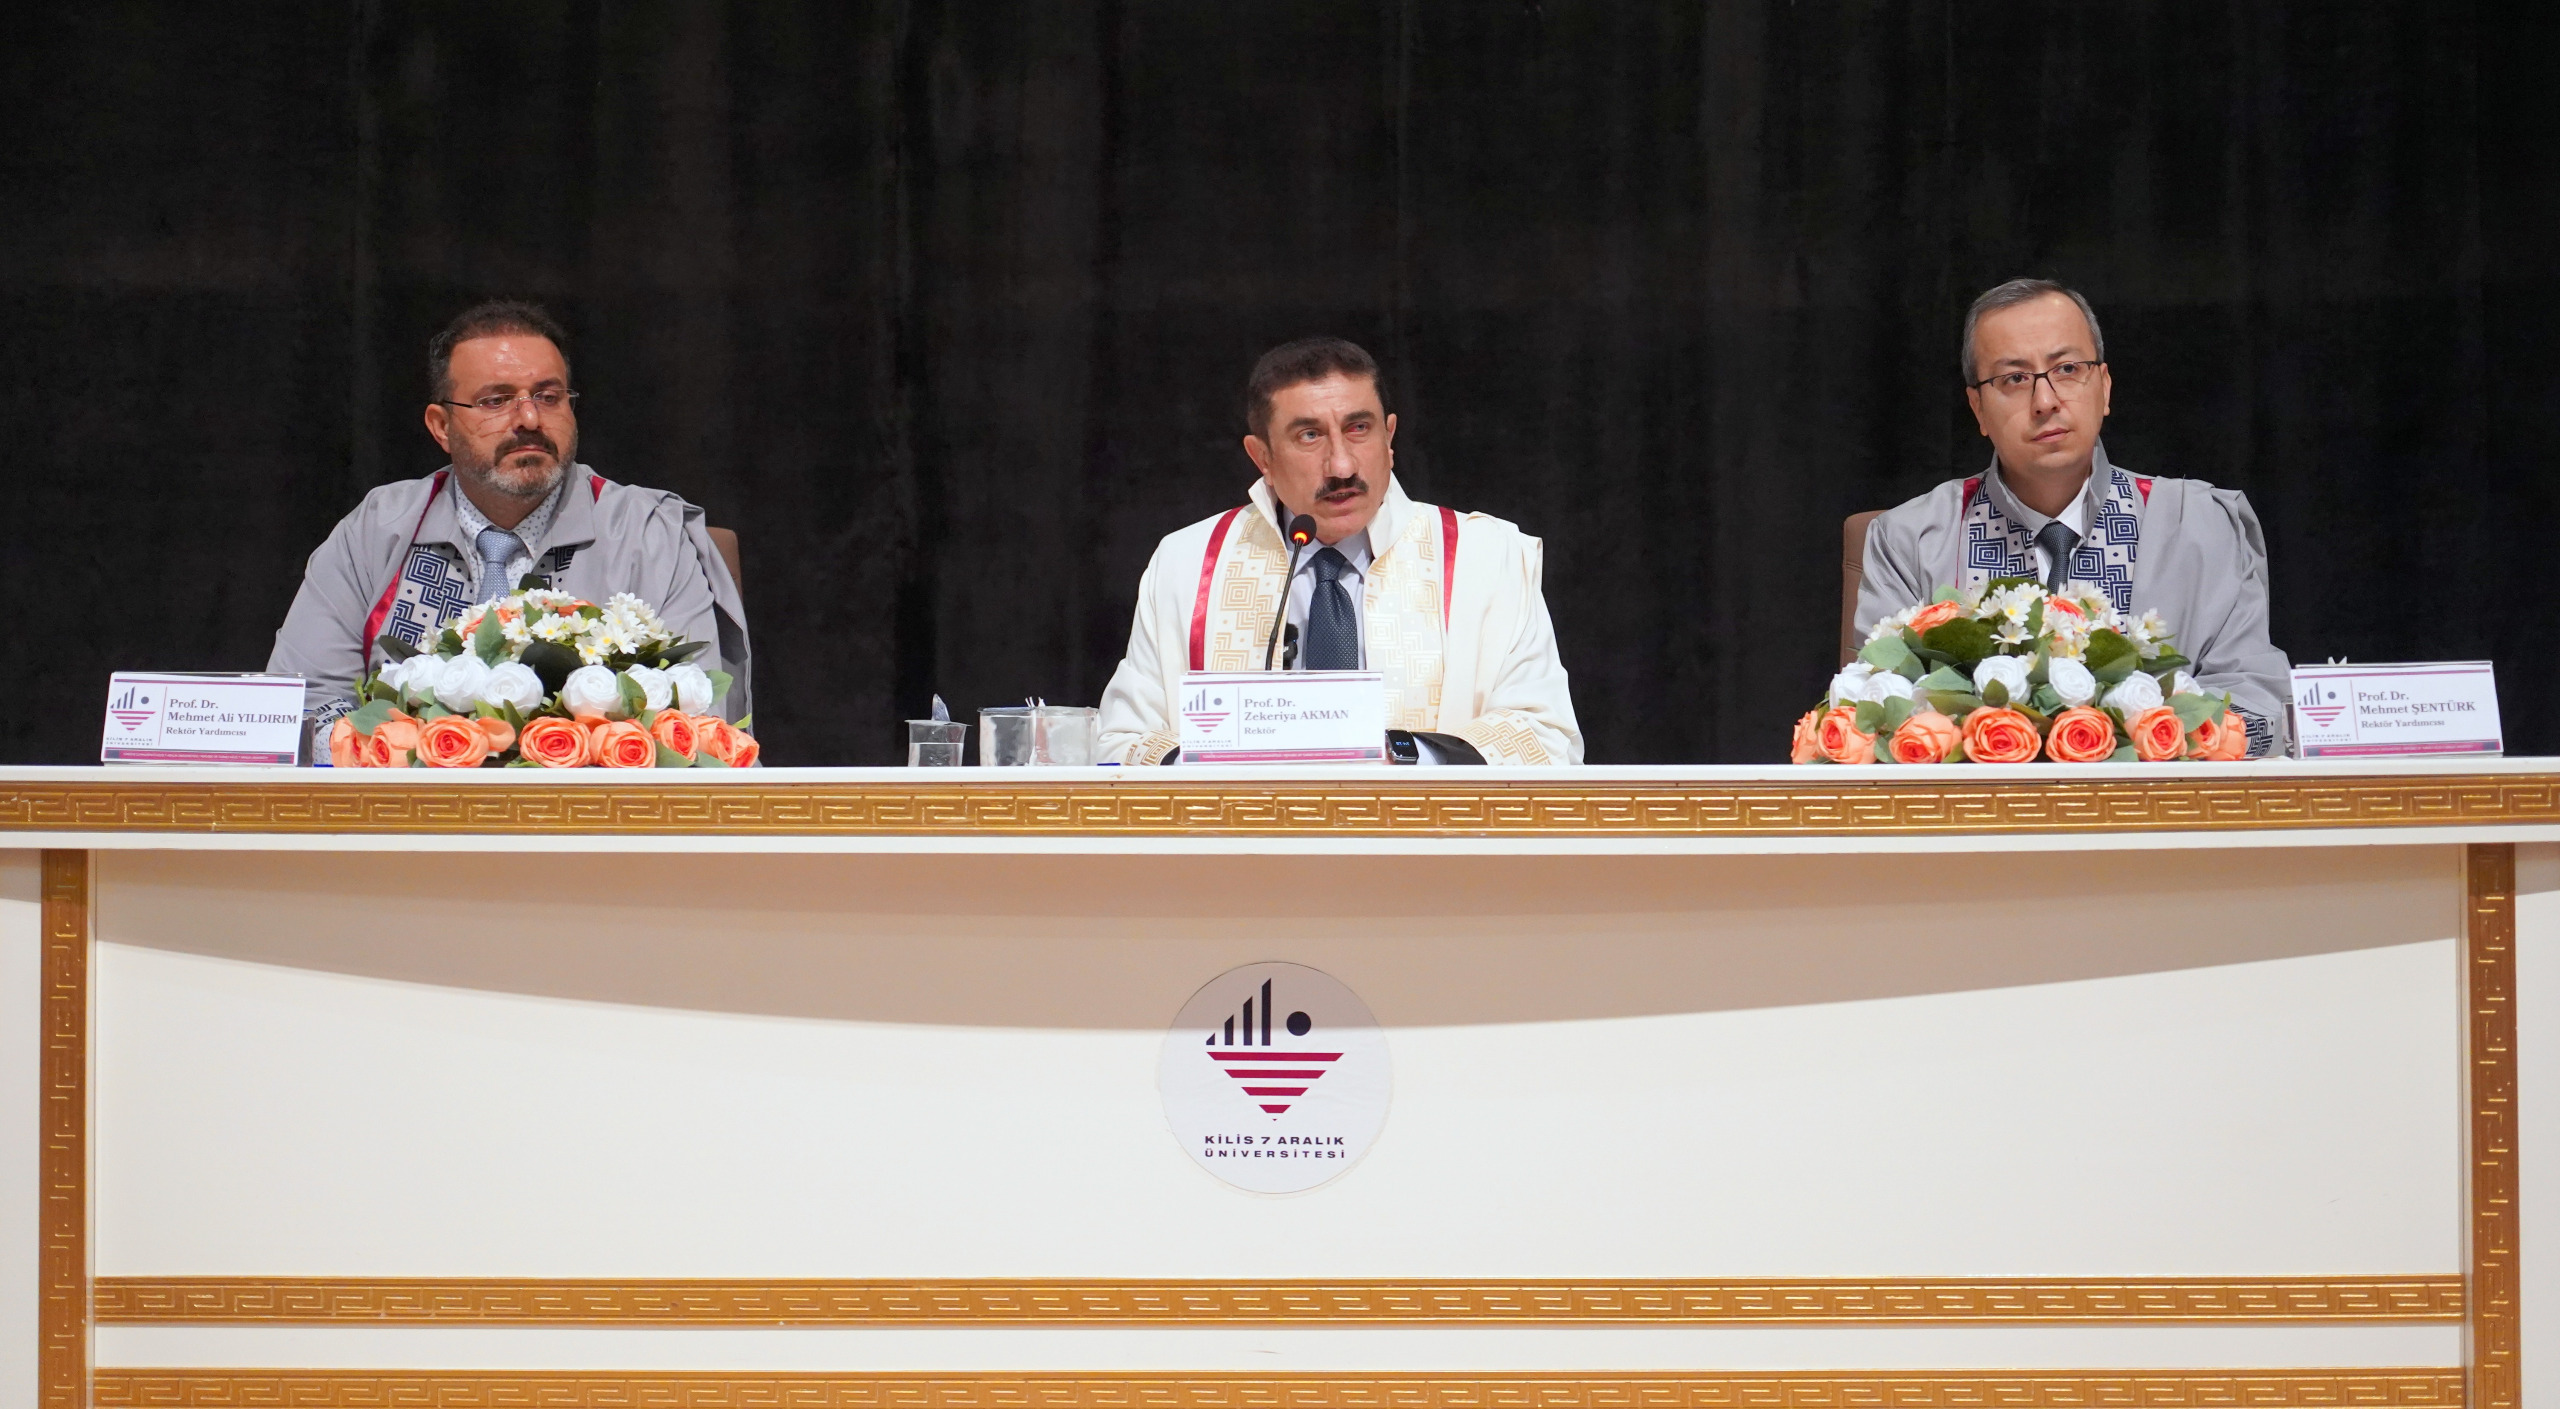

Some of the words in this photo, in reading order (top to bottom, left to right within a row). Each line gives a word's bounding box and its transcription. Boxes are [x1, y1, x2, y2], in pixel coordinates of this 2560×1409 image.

[2358, 691, 2388, 701] Prof.
[2390, 690, 2410, 701] Dr.
[169, 698, 198, 709] Prof.
[200, 699, 219, 709] Dr.
[1244, 698, 1274, 708] Prof.
[1277, 698, 1296, 708] Dr.
[2359, 704, 2409, 715] Mehmet
[2411, 699, 2476, 715] ŞENTÜRK
[167, 711, 215, 722] Mehmet
[217, 713, 234, 723] Ali
[237, 713, 298, 724] YILDIRIM
[1244, 711, 1297, 723] Zekeriya
[1300, 709, 1349, 720] AKMAN
[2361, 720, 2393, 728] Rektör
[2395, 718, 2445, 728] Yardımcısı
[166, 726, 197, 735] Rektör
[199, 727, 247, 736] Yardımcısı
[1244, 726, 1276, 735] Rektör
[1204, 1134, 1254, 1144] KİLİS
[1260, 1136, 1271, 1145] 7
[1277, 1136, 1344, 1145] ARALIK
[1204, 1148, 1345, 1158] ÜNİVERSİTESİ
